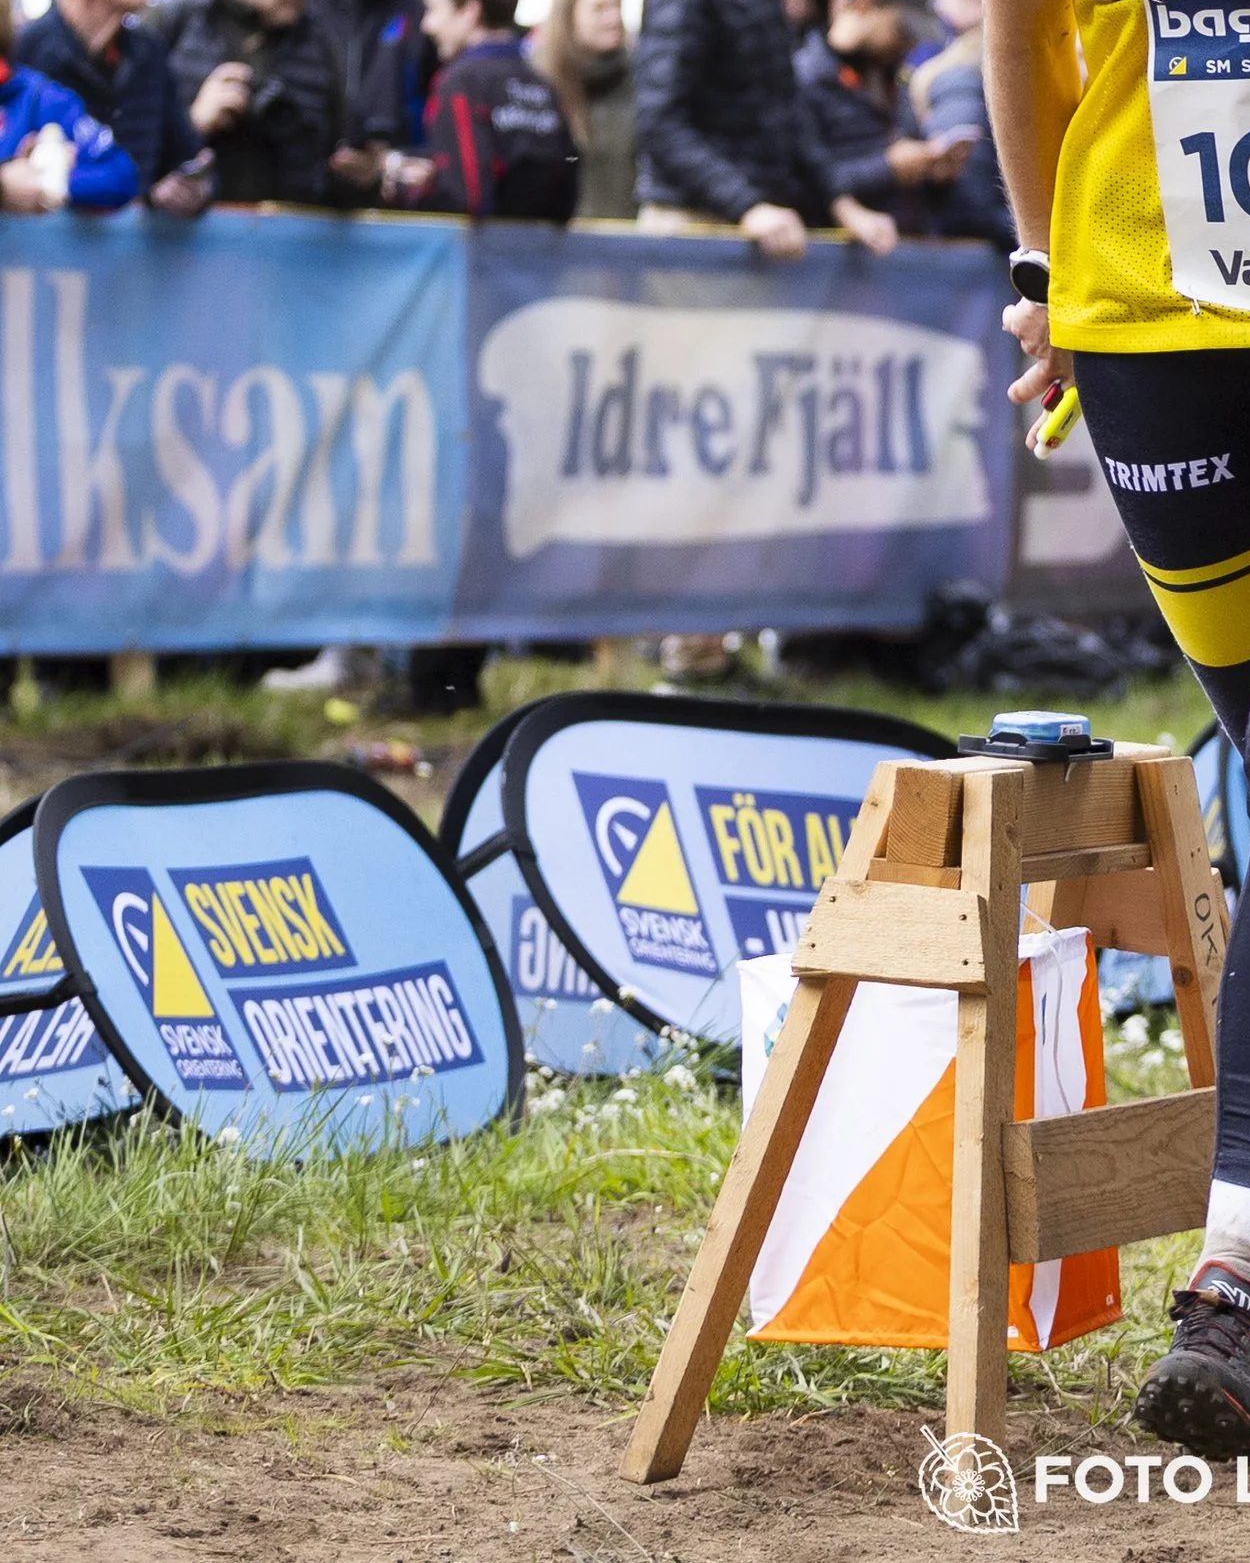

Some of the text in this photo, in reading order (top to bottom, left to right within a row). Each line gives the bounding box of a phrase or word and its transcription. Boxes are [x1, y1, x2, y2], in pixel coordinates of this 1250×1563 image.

[1205, 58, 1232, 74] SM
[1105, 452, 1235, 493] TRIMTEX
[709, 792, 804, 889] FÖR
[185, 873, 346, 969] SVENSK
[619, 906, 709, 951] SVENSK
[627, 935, 718, 973] ORIENTERING
[161, 1023, 234, 1057] SVENSK
[243, 973, 473, 1086] ORIENTERING
[176, 1057, 243, 1080] ORIENTERING
